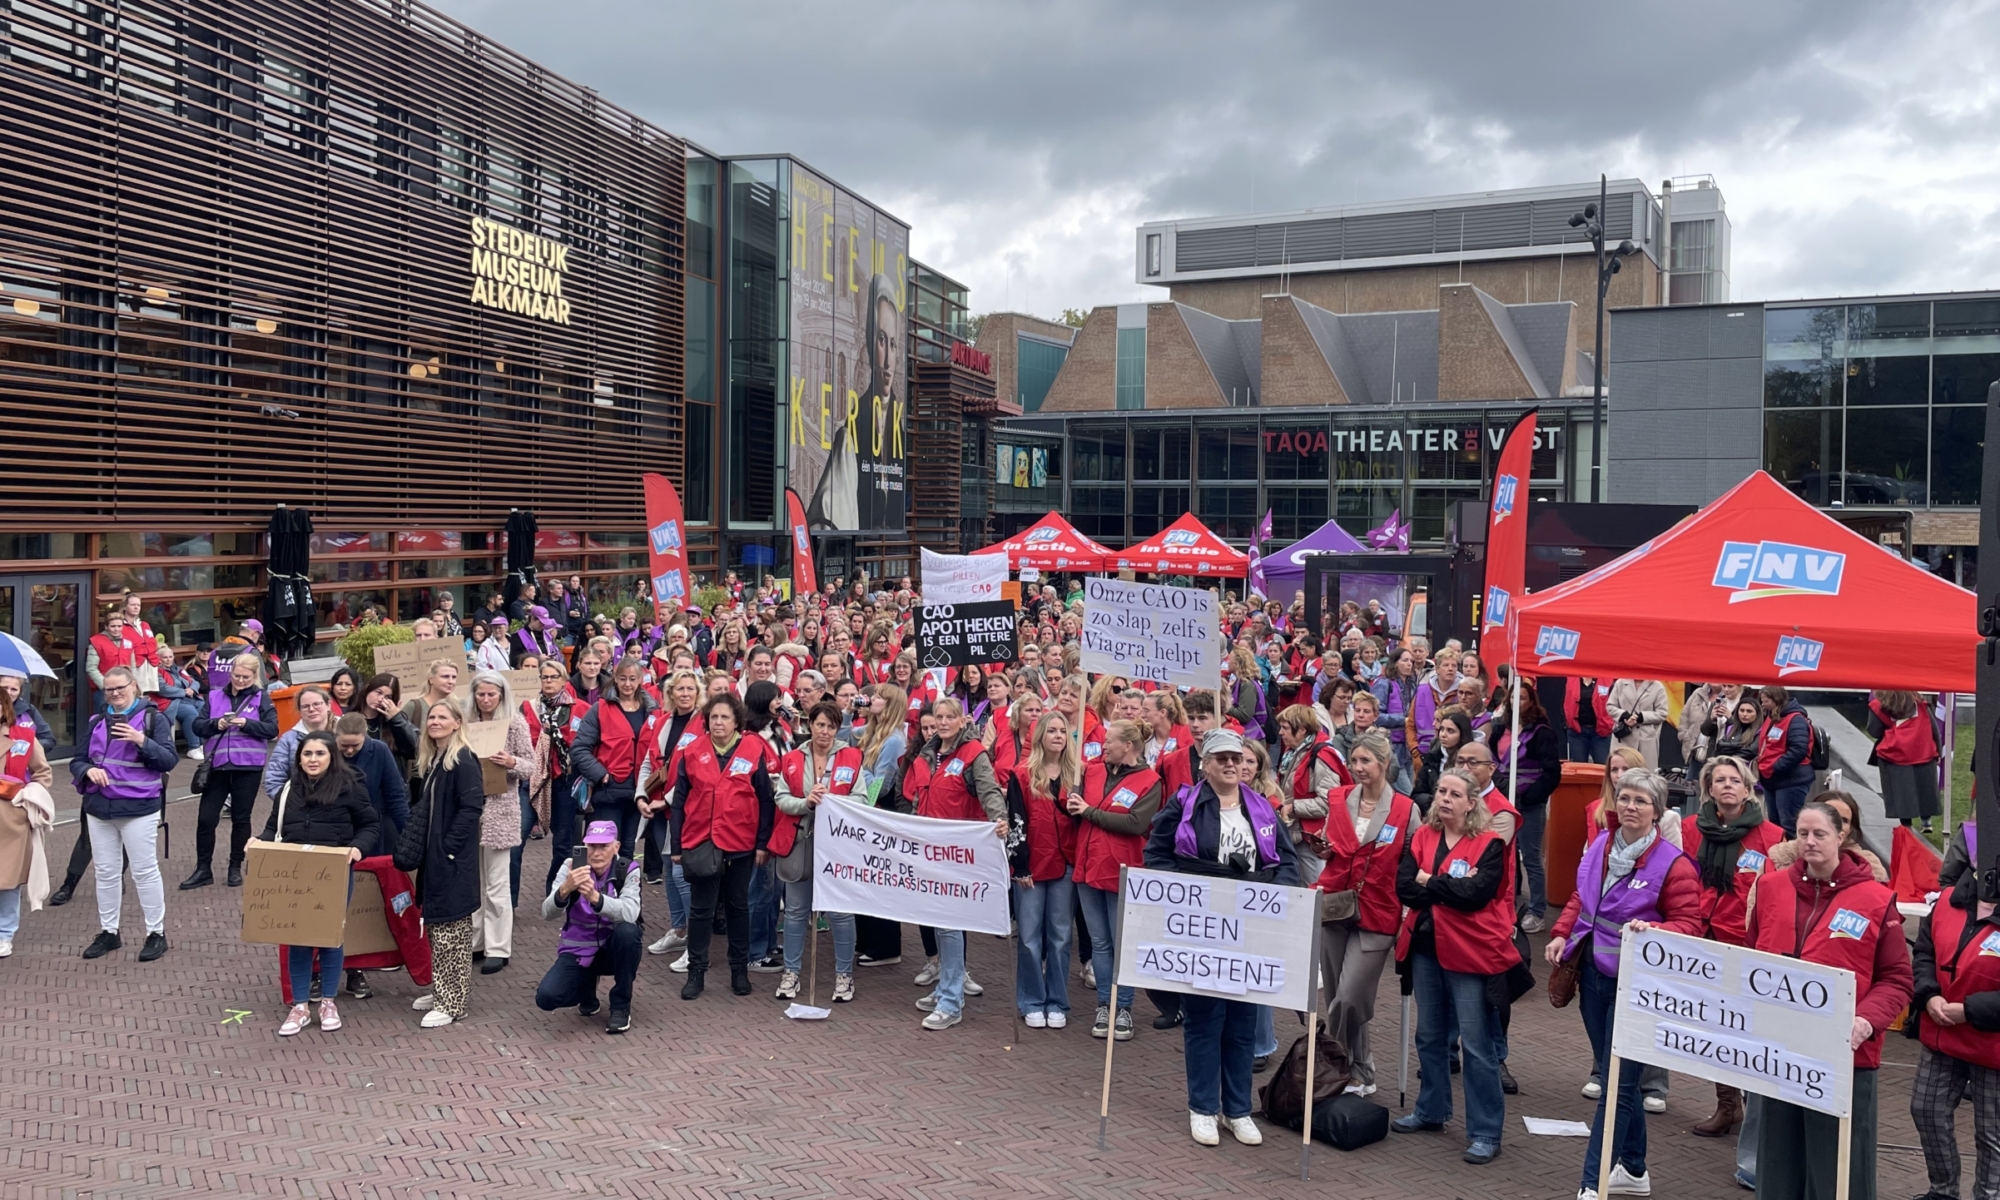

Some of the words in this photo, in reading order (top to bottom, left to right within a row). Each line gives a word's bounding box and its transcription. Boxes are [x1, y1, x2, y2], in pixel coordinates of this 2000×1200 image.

[472, 217, 568, 272] STEDELIJK
[472, 246, 561, 297] MUSEUM
[801, 278, 812, 292] sept
[813, 281, 825, 295] 2024
[471, 276, 571, 325] ALKMAAR
[1262, 431, 1328, 457] TAQA
[1332, 428, 1459, 452] THEATER
[1465, 428, 1478, 451] DE
[1487, 426, 1561, 451] VST
[1029, 528, 1061, 541] FNV
[1164, 530, 1199, 545] FNV
[1002, 541, 1021, 551] in
[1025, 542, 1077, 553] actie
[1140, 545, 1160, 553] in
[1165, 545, 1219, 556] actie
[1721, 552, 1840, 582] FNV
[971, 583, 991, 594] CAO
[1090, 581, 1136, 604] Onze
[1142, 586, 1187, 610] CAO
[1193, 591, 1208, 612] is
[922, 604, 955, 620] CAO
[1091, 611, 1111, 626] zo
[1116, 609, 1153, 641] slap,
[1162, 617, 1206, 640] zelfs
[923, 636, 934, 647] IS
[938, 635, 960, 646] EEN
[966, 631, 1011, 644] BITTERE
[970, 645, 987, 656] PIL
[1084, 630, 1145, 662] Viagra
[1154, 639, 1201, 670] helpt
[1539, 632, 1579, 652] FNV
[1778, 641, 1822, 662] FNV
[1134, 659, 1169, 681] niet
[828, 815, 867, 842] WAAR
[900, 840, 919, 856] DE
[924, 844, 975, 865] CENTEN
[257, 853, 299, 880] Laat
[315, 866, 332, 881] de
[863, 854, 892, 872] VOOR
[899, 862, 914, 878] DE
[252, 886, 316, 900] apotheek
[1127, 877, 1203, 907] VOOR
[1242, 887, 1281, 915] 2%
[249, 900, 271, 912] niet
[314, 901, 326, 911] de
[257, 916, 298, 930] Steek
[1166, 912, 1239, 942] GEEN
[1832, 913, 1867, 933] FNV
[1142, 947, 1281, 987] ASSISTENT
[1641, 940, 1717, 980] Onze
[1748, 967, 1829, 1009] CAO
[1637, 987, 1708, 1022] staat
[1718, 999, 1747, 1031] in
[1662, 1026, 1827, 1099] nazending
